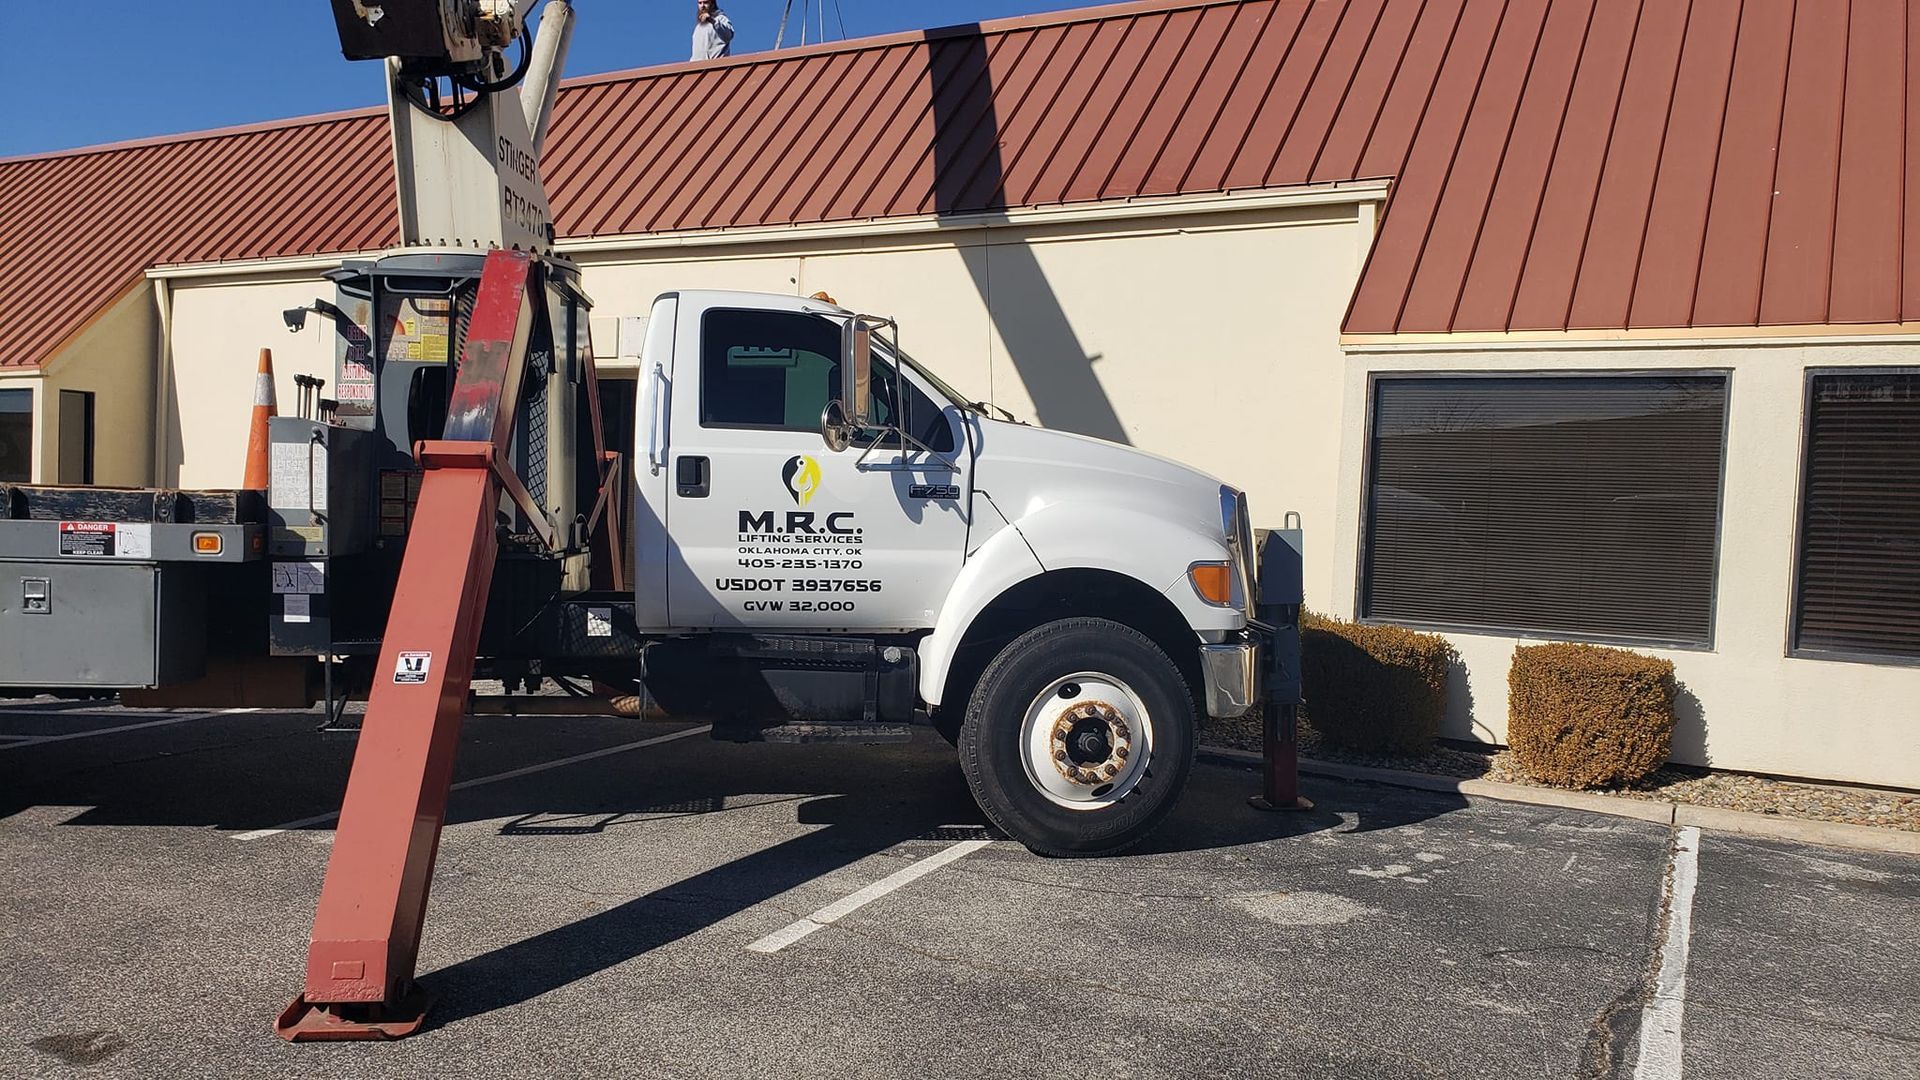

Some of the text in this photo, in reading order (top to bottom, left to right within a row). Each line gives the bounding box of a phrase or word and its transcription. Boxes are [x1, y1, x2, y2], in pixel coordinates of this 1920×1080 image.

[499, 135, 536, 185] STINGER
[504, 185, 544, 238] BT3470
[910, 485, 959, 495] F-750
[77, 523, 109, 531] DANGER
[738, 510, 863, 534] M.R.C.
[738, 534, 863, 544] LIFTING SERVICES
[738, 546, 862, 556] OKLAHOMA CITY, OK
[738, 558, 863, 569] 405-235-1370
[715, 578, 882, 593] USDOT 3937656
[743, 600, 855, 613] GVW 32,000
